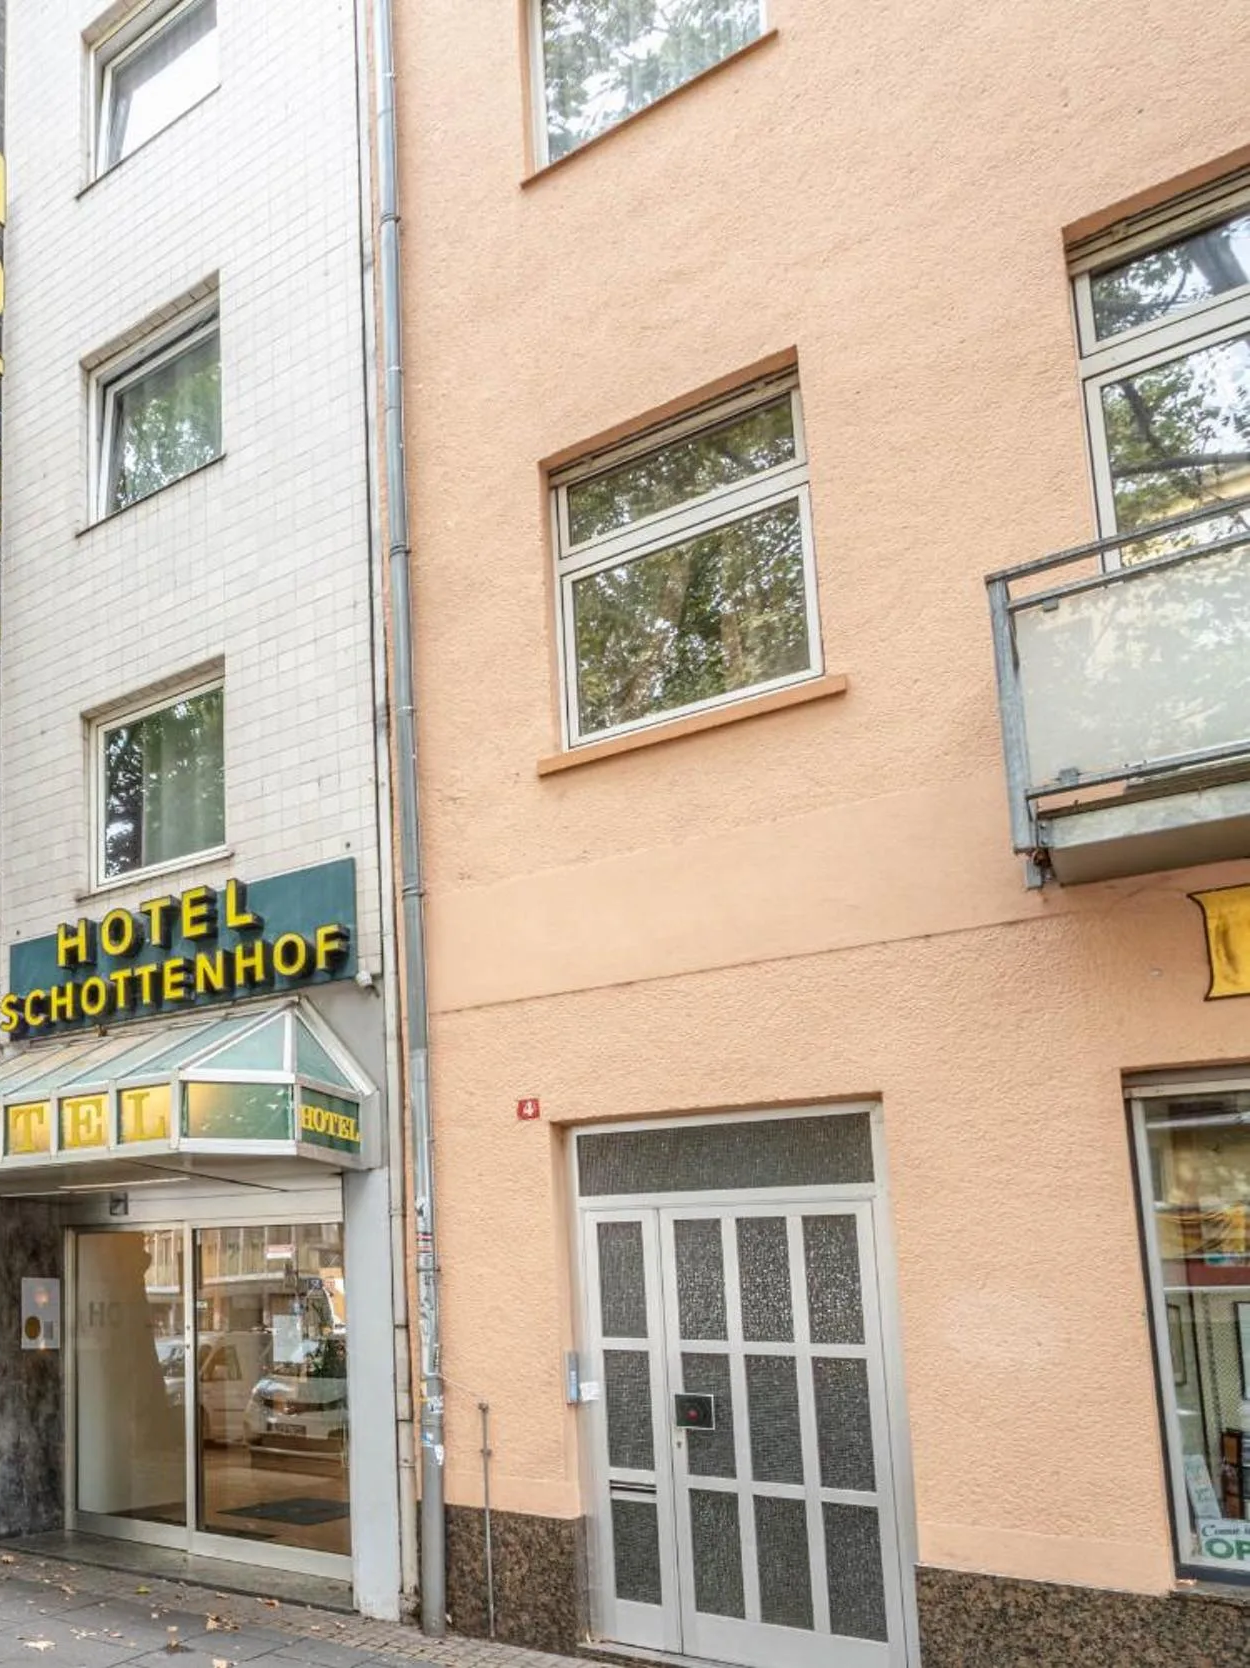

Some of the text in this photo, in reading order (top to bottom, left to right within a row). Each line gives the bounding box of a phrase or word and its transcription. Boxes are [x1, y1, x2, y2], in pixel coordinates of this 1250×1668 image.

[56, 877, 263, 969] HOTEL
[0, 922, 350, 1032] SCHOTTENHOF
[299, 1104, 362, 1142] HOTEL
